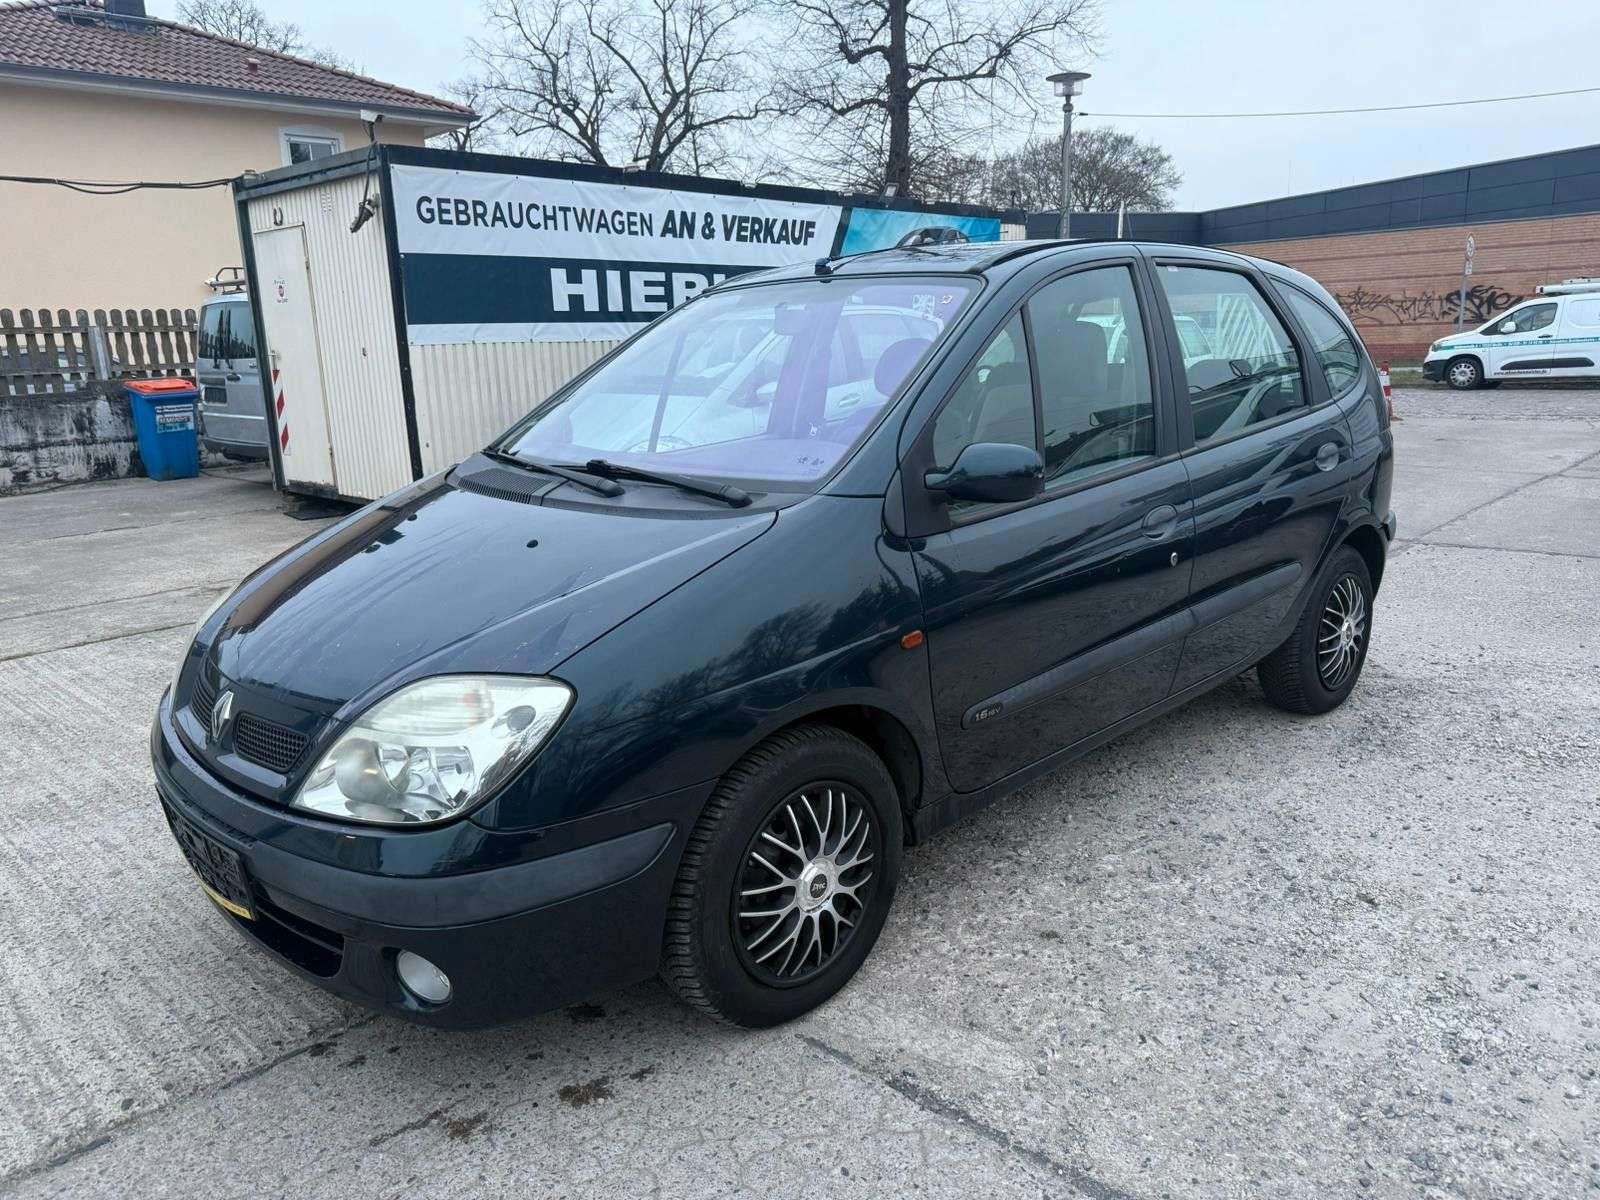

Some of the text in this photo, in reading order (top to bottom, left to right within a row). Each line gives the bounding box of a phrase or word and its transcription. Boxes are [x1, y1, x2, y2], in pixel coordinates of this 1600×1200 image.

[416, 196, 816, 246] GEBRAUCHTWAGEN AN & VERKAUF
